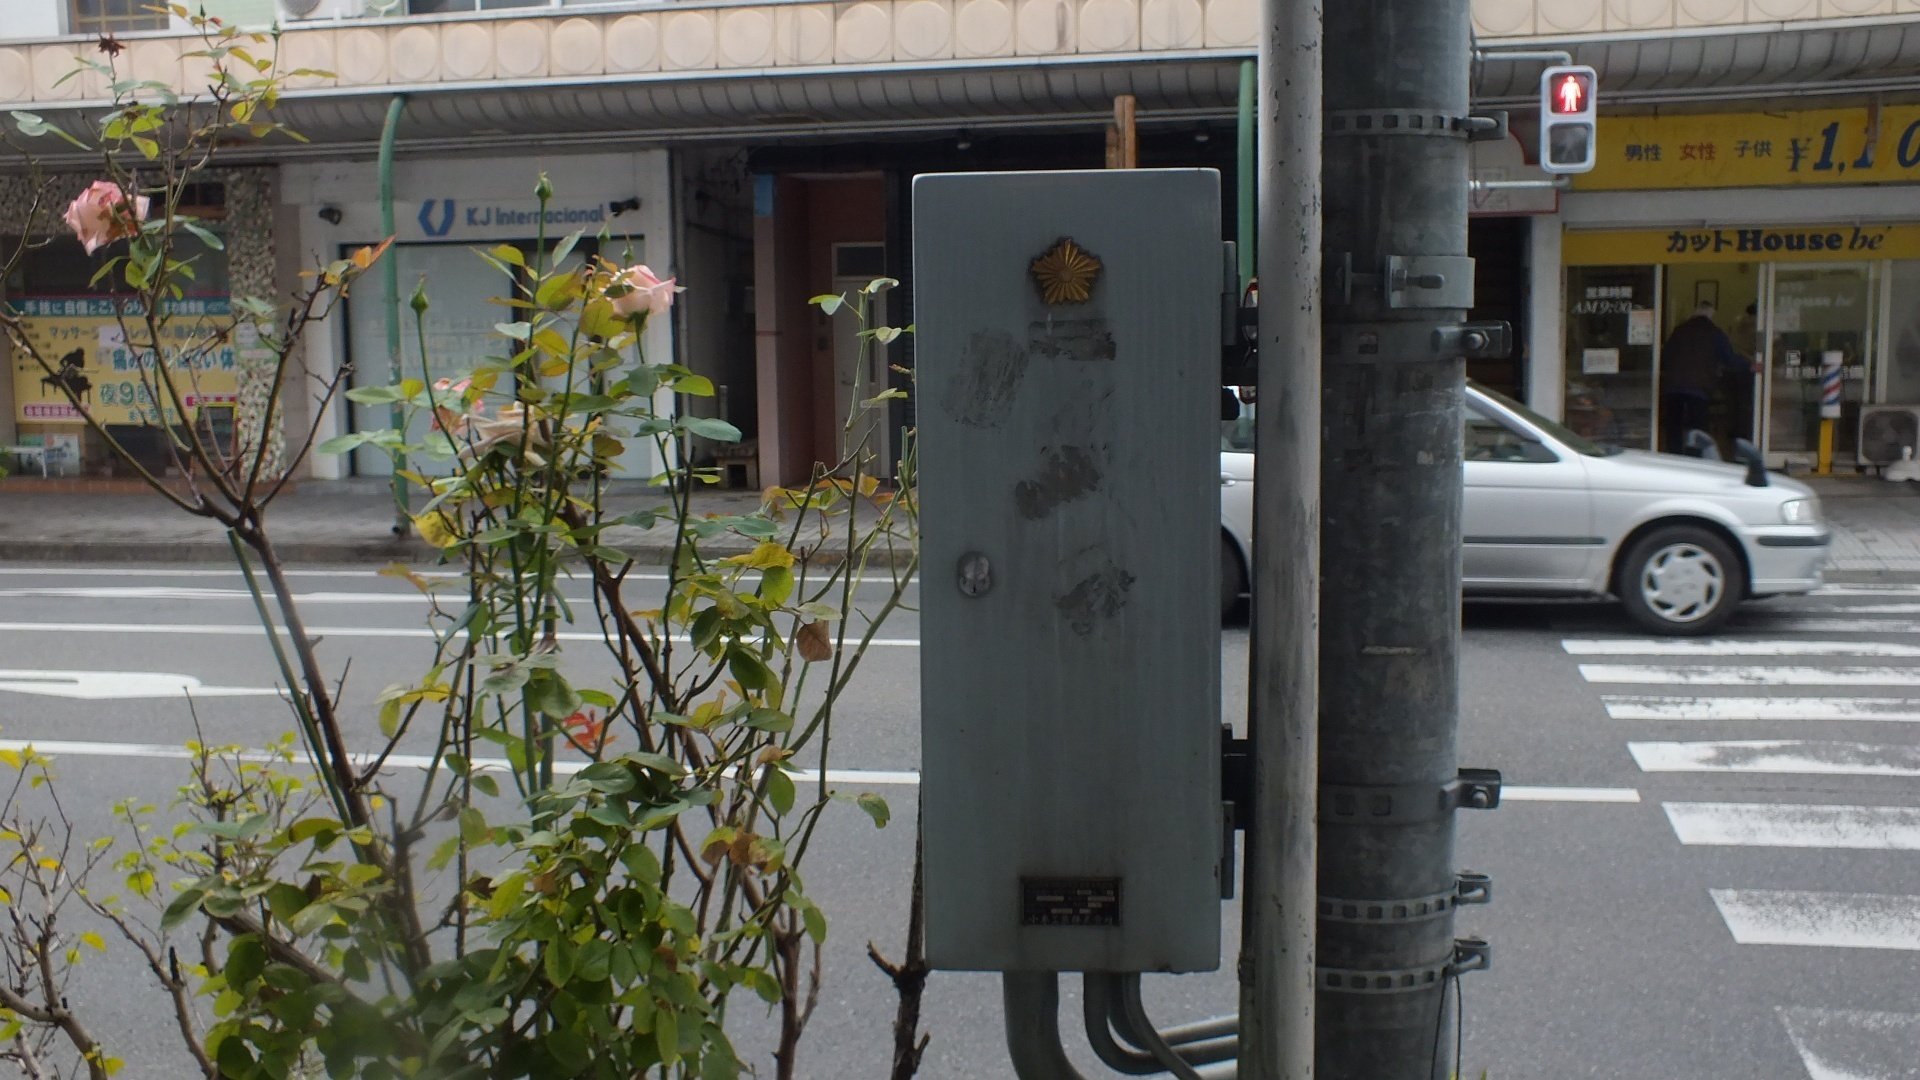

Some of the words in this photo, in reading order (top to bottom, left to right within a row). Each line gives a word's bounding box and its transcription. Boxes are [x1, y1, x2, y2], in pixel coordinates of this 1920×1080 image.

[1625, 143, 1662, 162] 男性
[1679, 142, 1716, 161] 女性
[1734, 139, 1772, 158] 子供
[467, 207, 491, 226] KJ
[496, 204, 604, 225] Internacional
